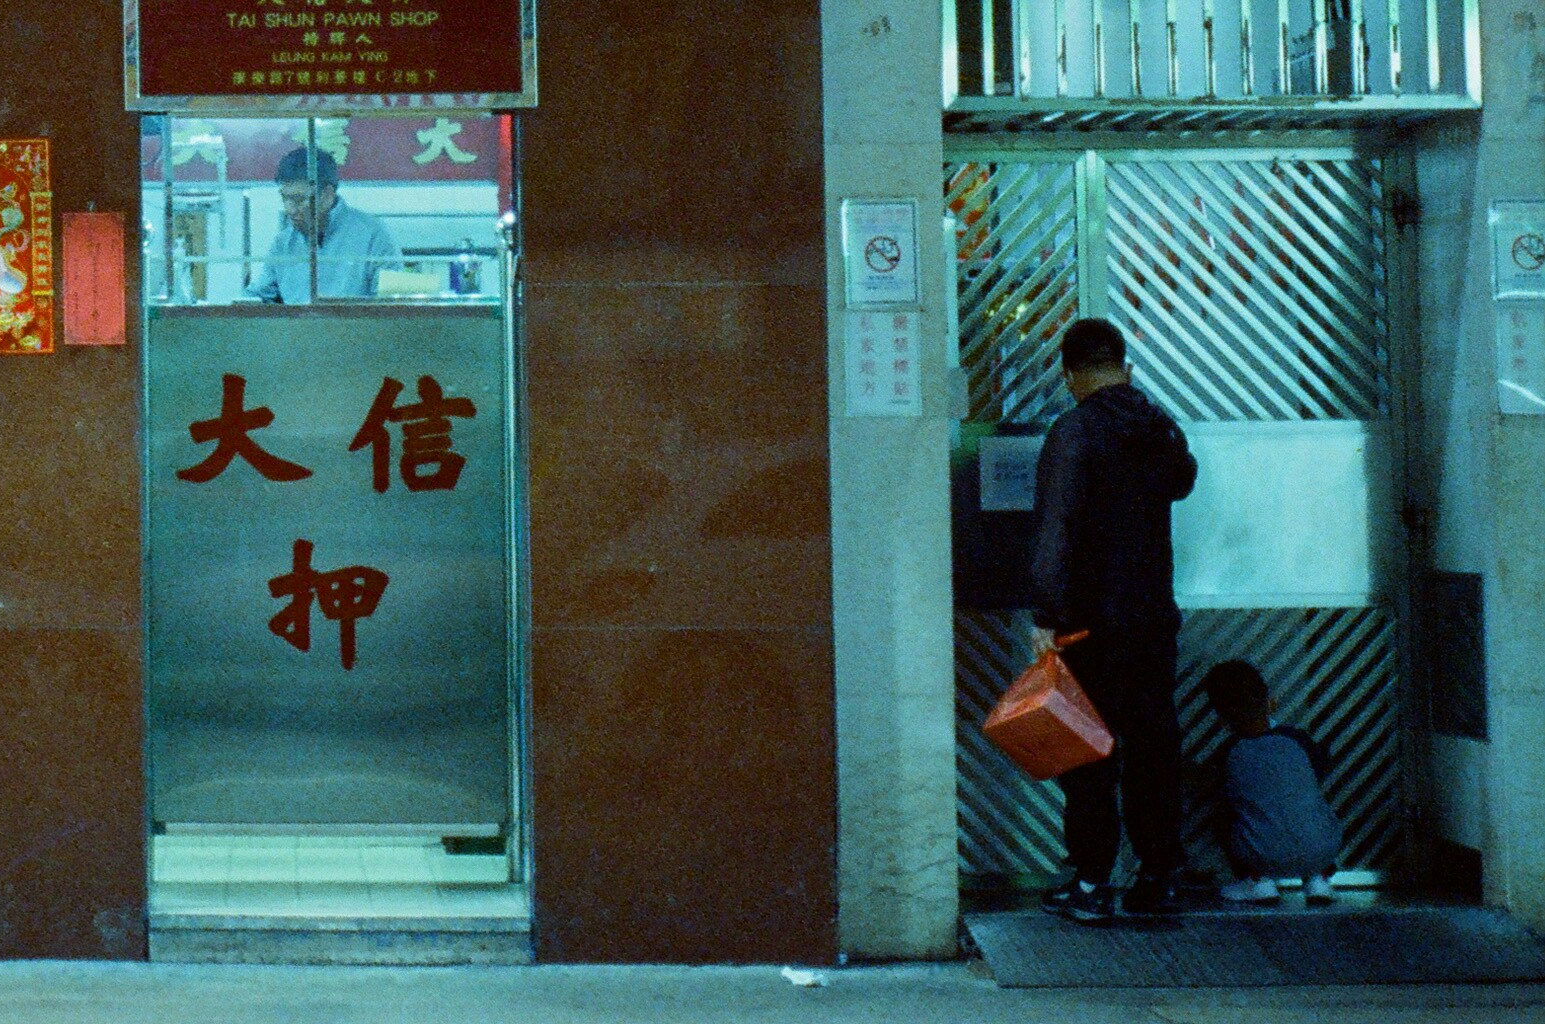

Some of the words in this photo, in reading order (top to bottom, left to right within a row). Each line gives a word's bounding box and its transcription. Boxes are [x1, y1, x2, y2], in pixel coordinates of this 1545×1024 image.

[228, 12, 255, 27] TAI
[264, 12, 315, 27] SHUN
[324, 12, 381, 27] PAWN
[390, 11, 440, 26] SHOP
[272, 51, 315, 63] LEUNG
[176, 373, 476, 493] 大信
[268, 538, 389, 671] 押
